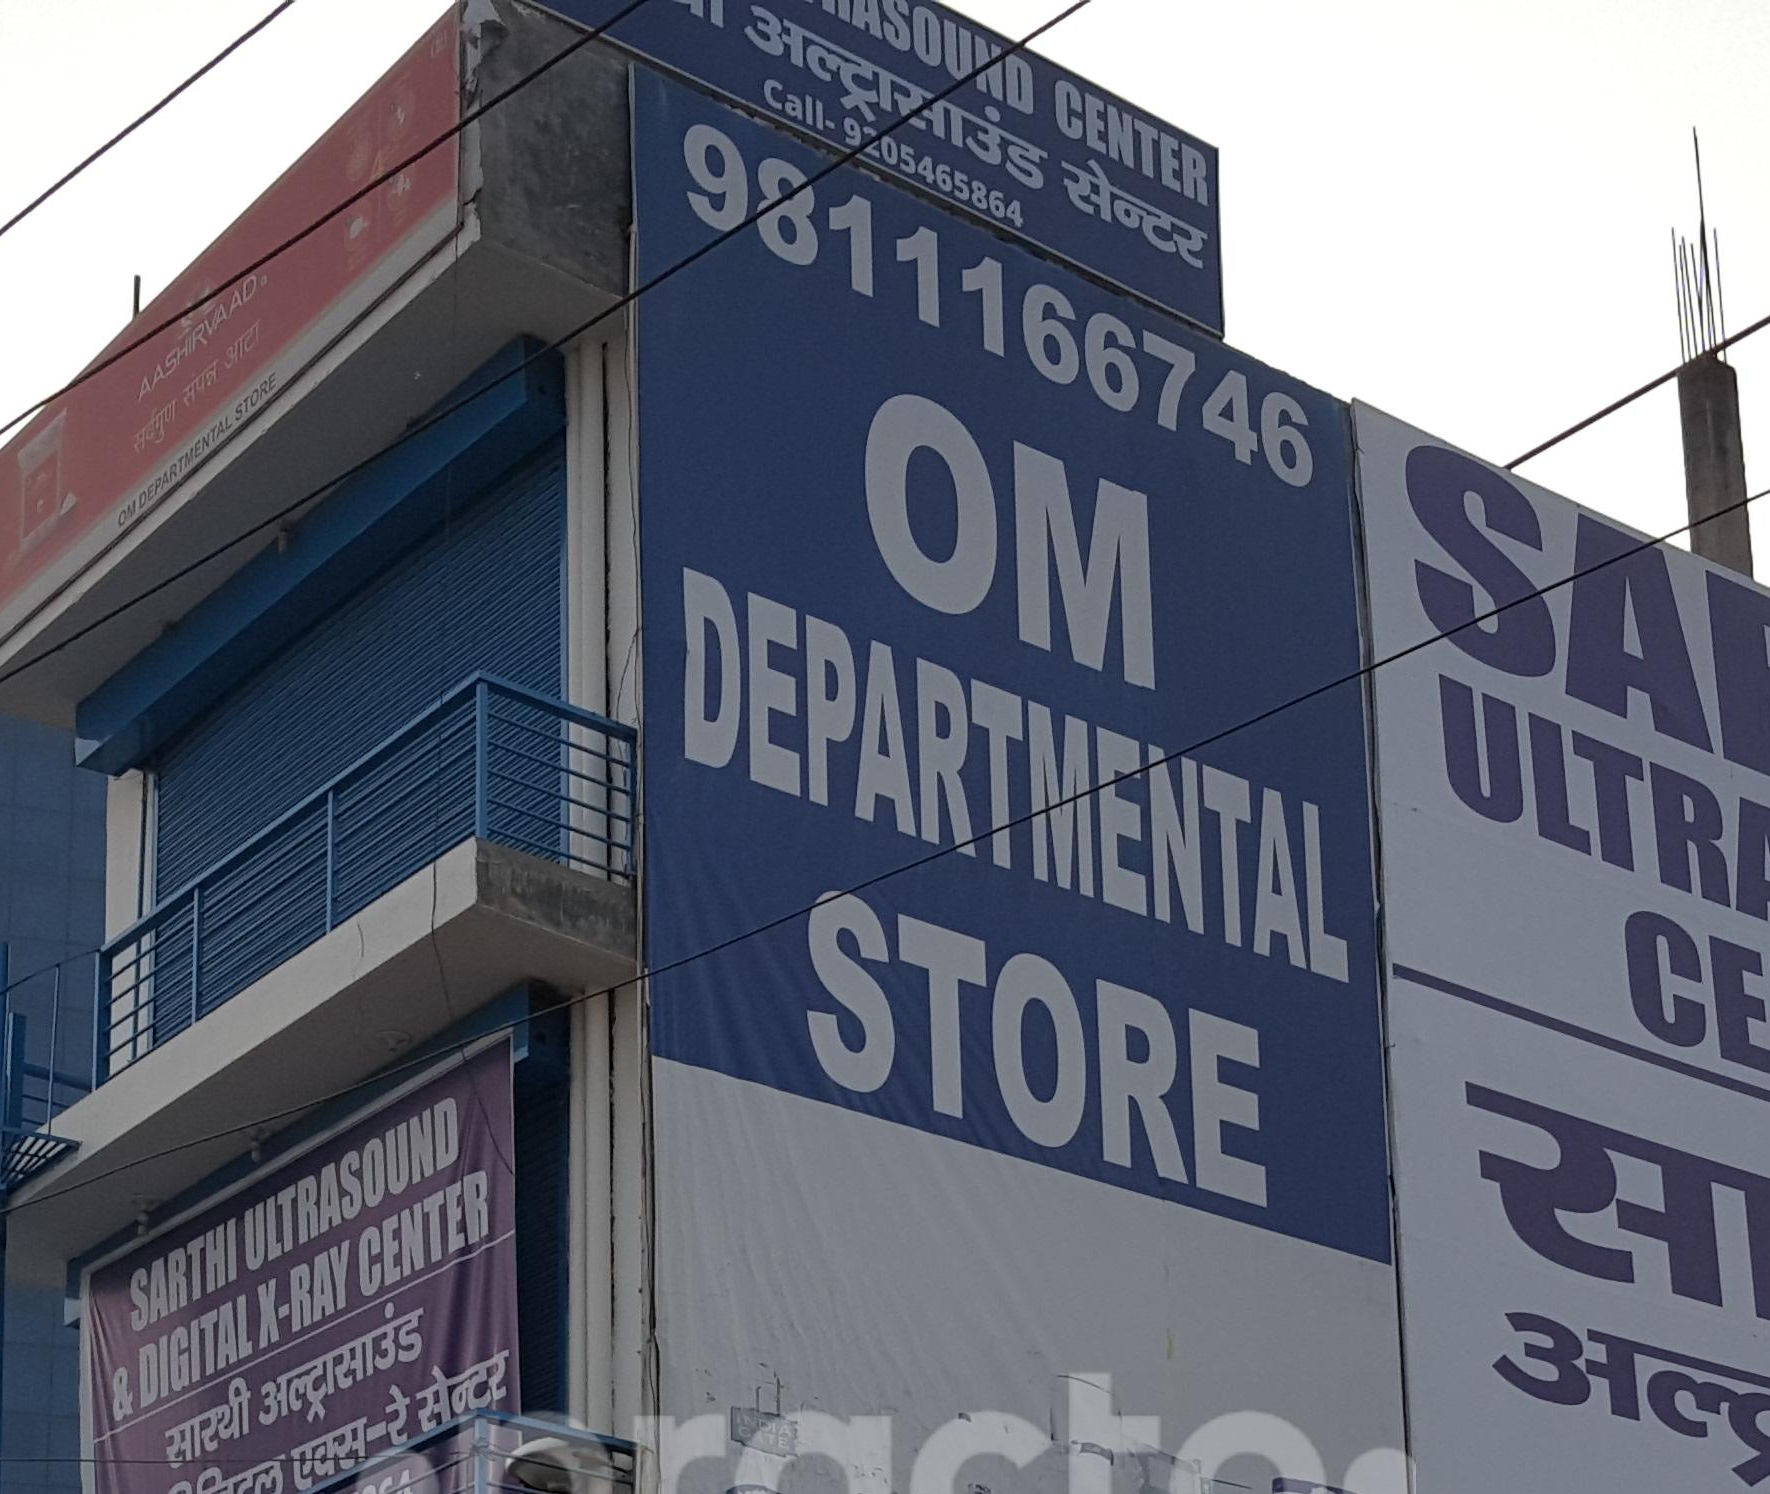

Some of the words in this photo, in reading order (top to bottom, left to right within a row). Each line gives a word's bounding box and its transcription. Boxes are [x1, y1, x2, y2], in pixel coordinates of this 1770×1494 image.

[744, 4, 1048, 190] अल्ट्रासाउंड
[1061, 157, 1208, 269] सेन्टर
[763, 78, 836, 132] Call-
[843, 117, 1025, 228] 9205465864
[804, 0, 1033, 115] ASOUND
[1055, 79, 1209, 206] CENTER
[137, 275, 257, 402] AASHIRVAAD
[683, 123, 1314, 488] 9811166746
[117, 503, 137, 527] OM
[139, 415, 232, 509] DEPARTMENTAL
[235, 371, 277, 422] STORE
[864, 394, 1157, 691] OM
[683, 566, 1349, 984] DEPARTMENTAL
[806, 890, 1268, 1208] STORE
[112, 1366, 134, 1422] &
[138, 1300, 255, 1408] DIGITAL
[259, 1242, 349, 1350] X-RAY
[359, 1168, 490, 1299] CENTER
[130, 1210, 238, 1332] SARTHI
[244, 1097, 459, 1272] ULTRASOUND
[165, 1372, 250, 1468] सारथी
[258, 1303, 424, 1424] अल्ट्रासाउंड
[417, 1350, 509, 1430] सेन्टर
